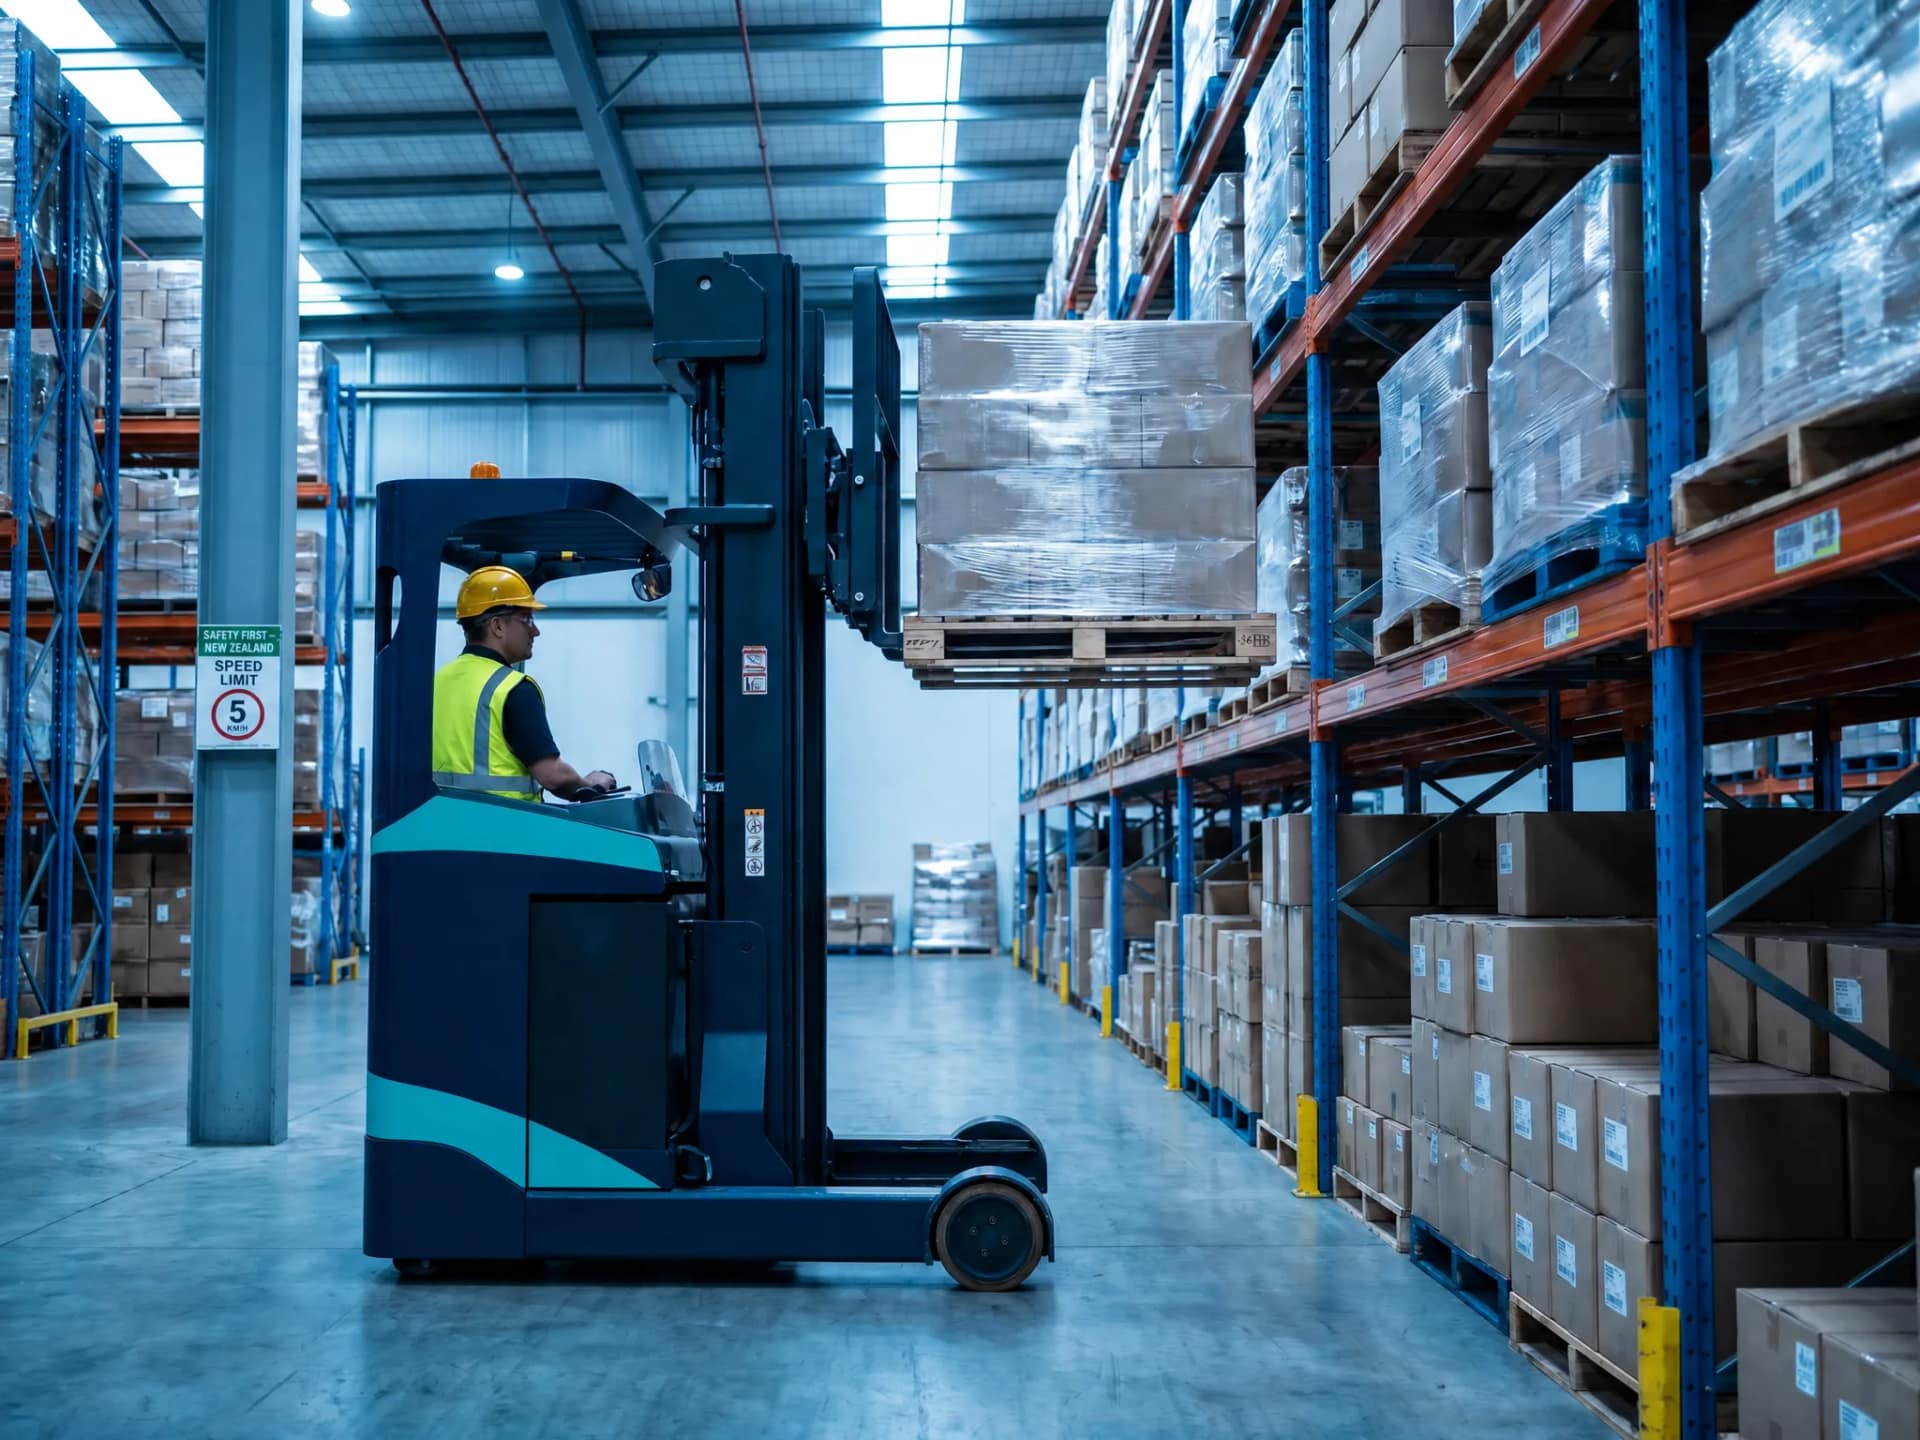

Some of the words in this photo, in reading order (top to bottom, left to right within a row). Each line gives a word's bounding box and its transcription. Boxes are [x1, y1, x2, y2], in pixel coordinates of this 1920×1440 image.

[203, 630, 239, 640] SAFETY
[241, 630, 267, 640] FIRST
[204, 643, 227, 653] NEW
[229, 643, 274, 653] ZEALAND
[215, 660, 263, 672] SPEED
[220, 674, 258, 686] LIMIT
[229, 700, 246, 723] 5
